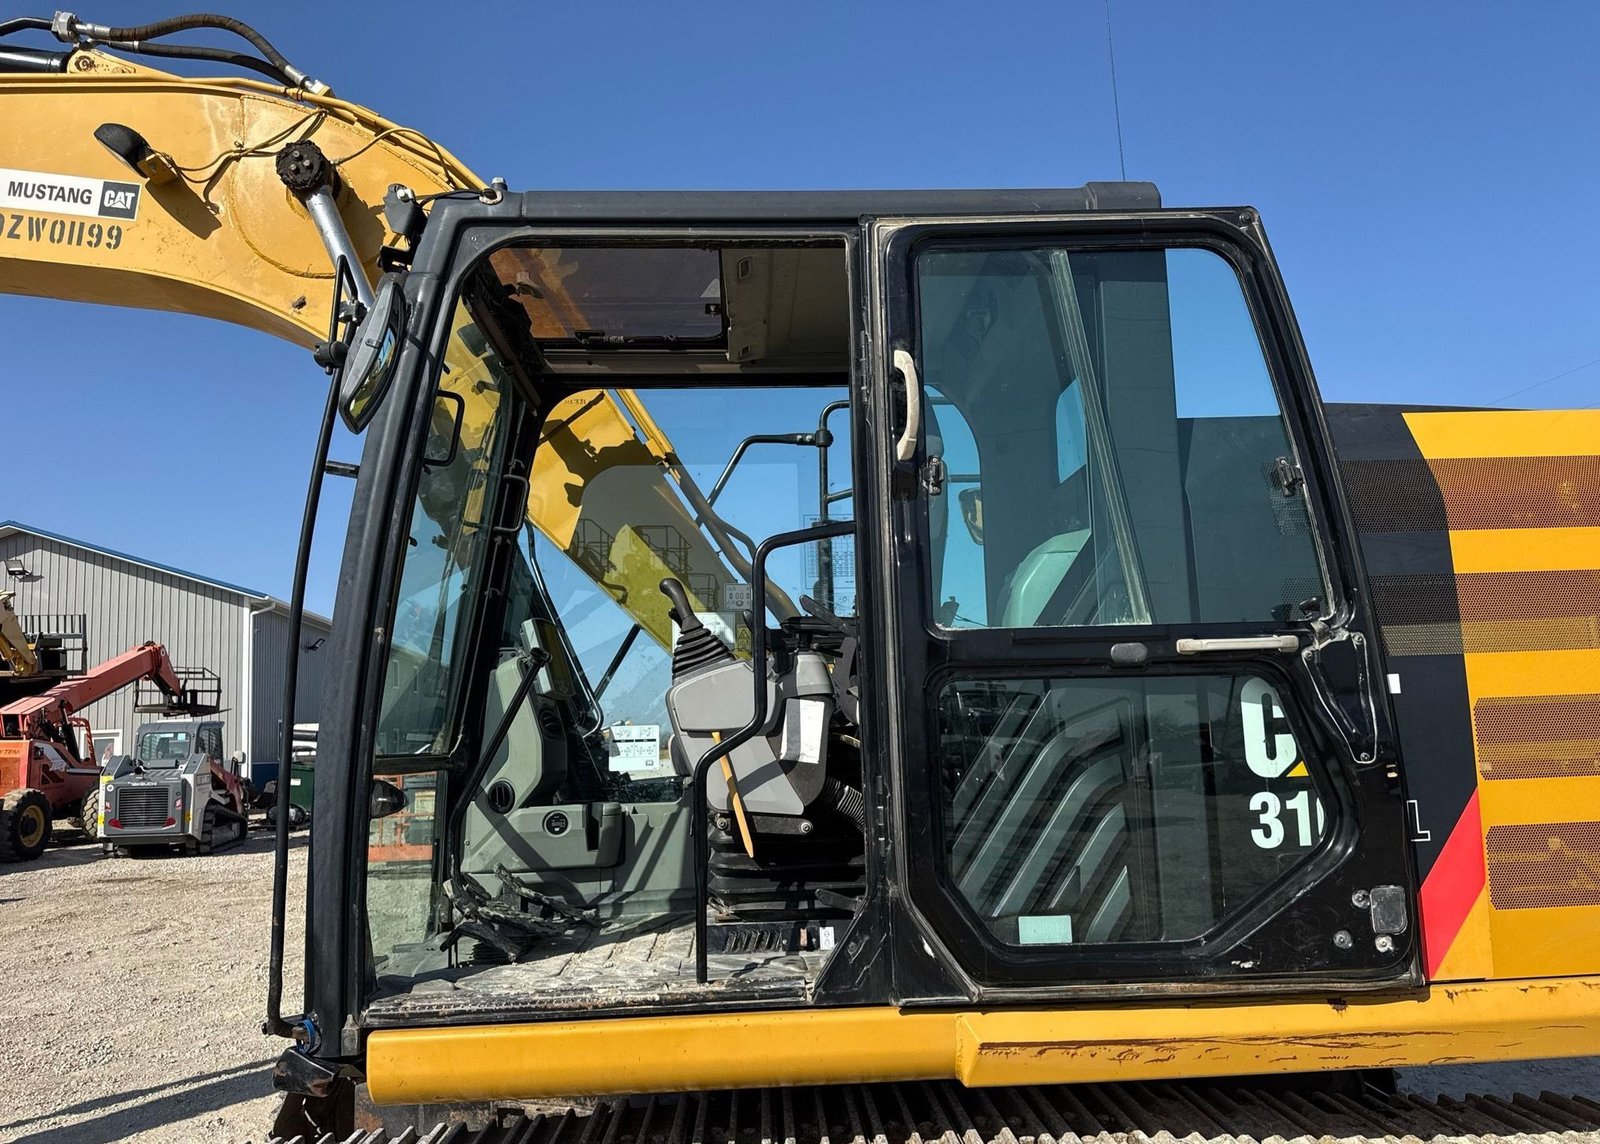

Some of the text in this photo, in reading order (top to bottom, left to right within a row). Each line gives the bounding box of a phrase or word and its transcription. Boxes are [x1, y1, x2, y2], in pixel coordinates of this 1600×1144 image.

[7, 181, 136, 210] MUSTANG CAT
[1249, 791, 1325, 849] 31
